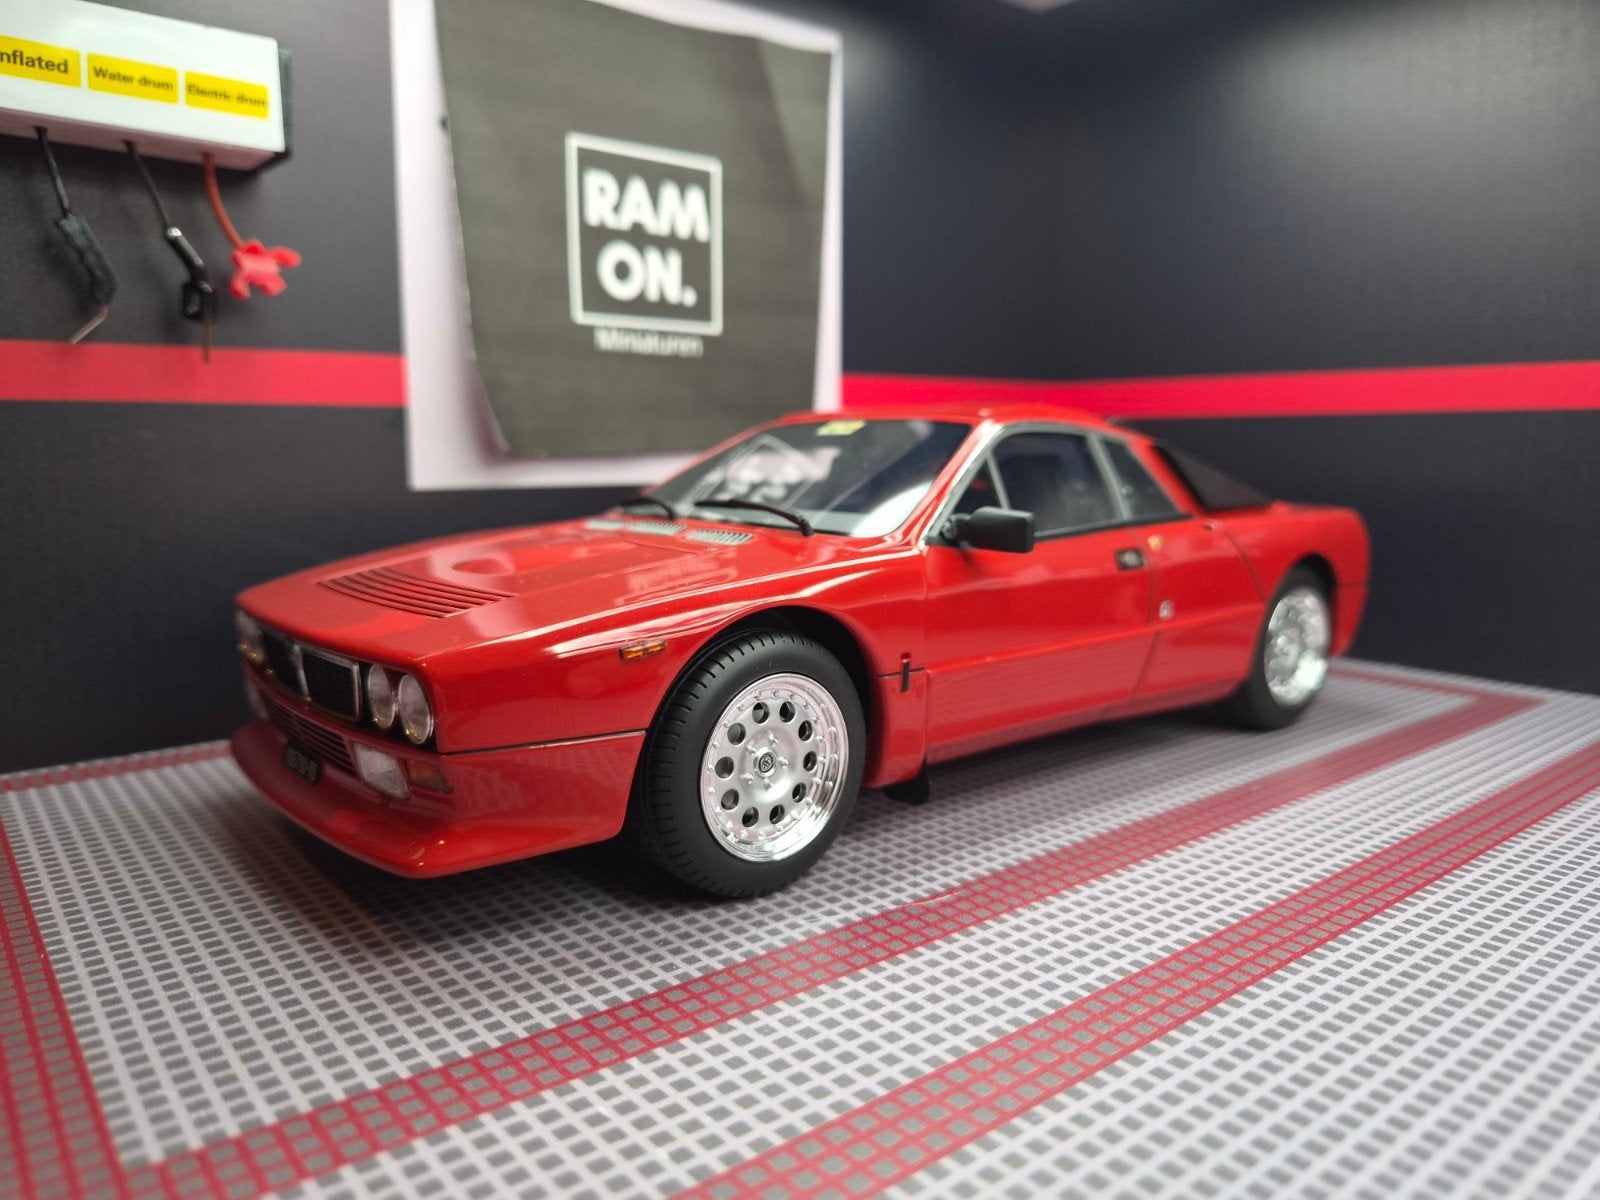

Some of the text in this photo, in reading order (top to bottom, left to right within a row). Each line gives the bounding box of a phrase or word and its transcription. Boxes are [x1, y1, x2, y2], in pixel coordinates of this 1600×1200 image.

[0, 50, 69, 74] nflated
[93, 66, 174, 91] Water drum
[582, 166, 710, 243] RAM
[597, 239, 698, 308] ON.
